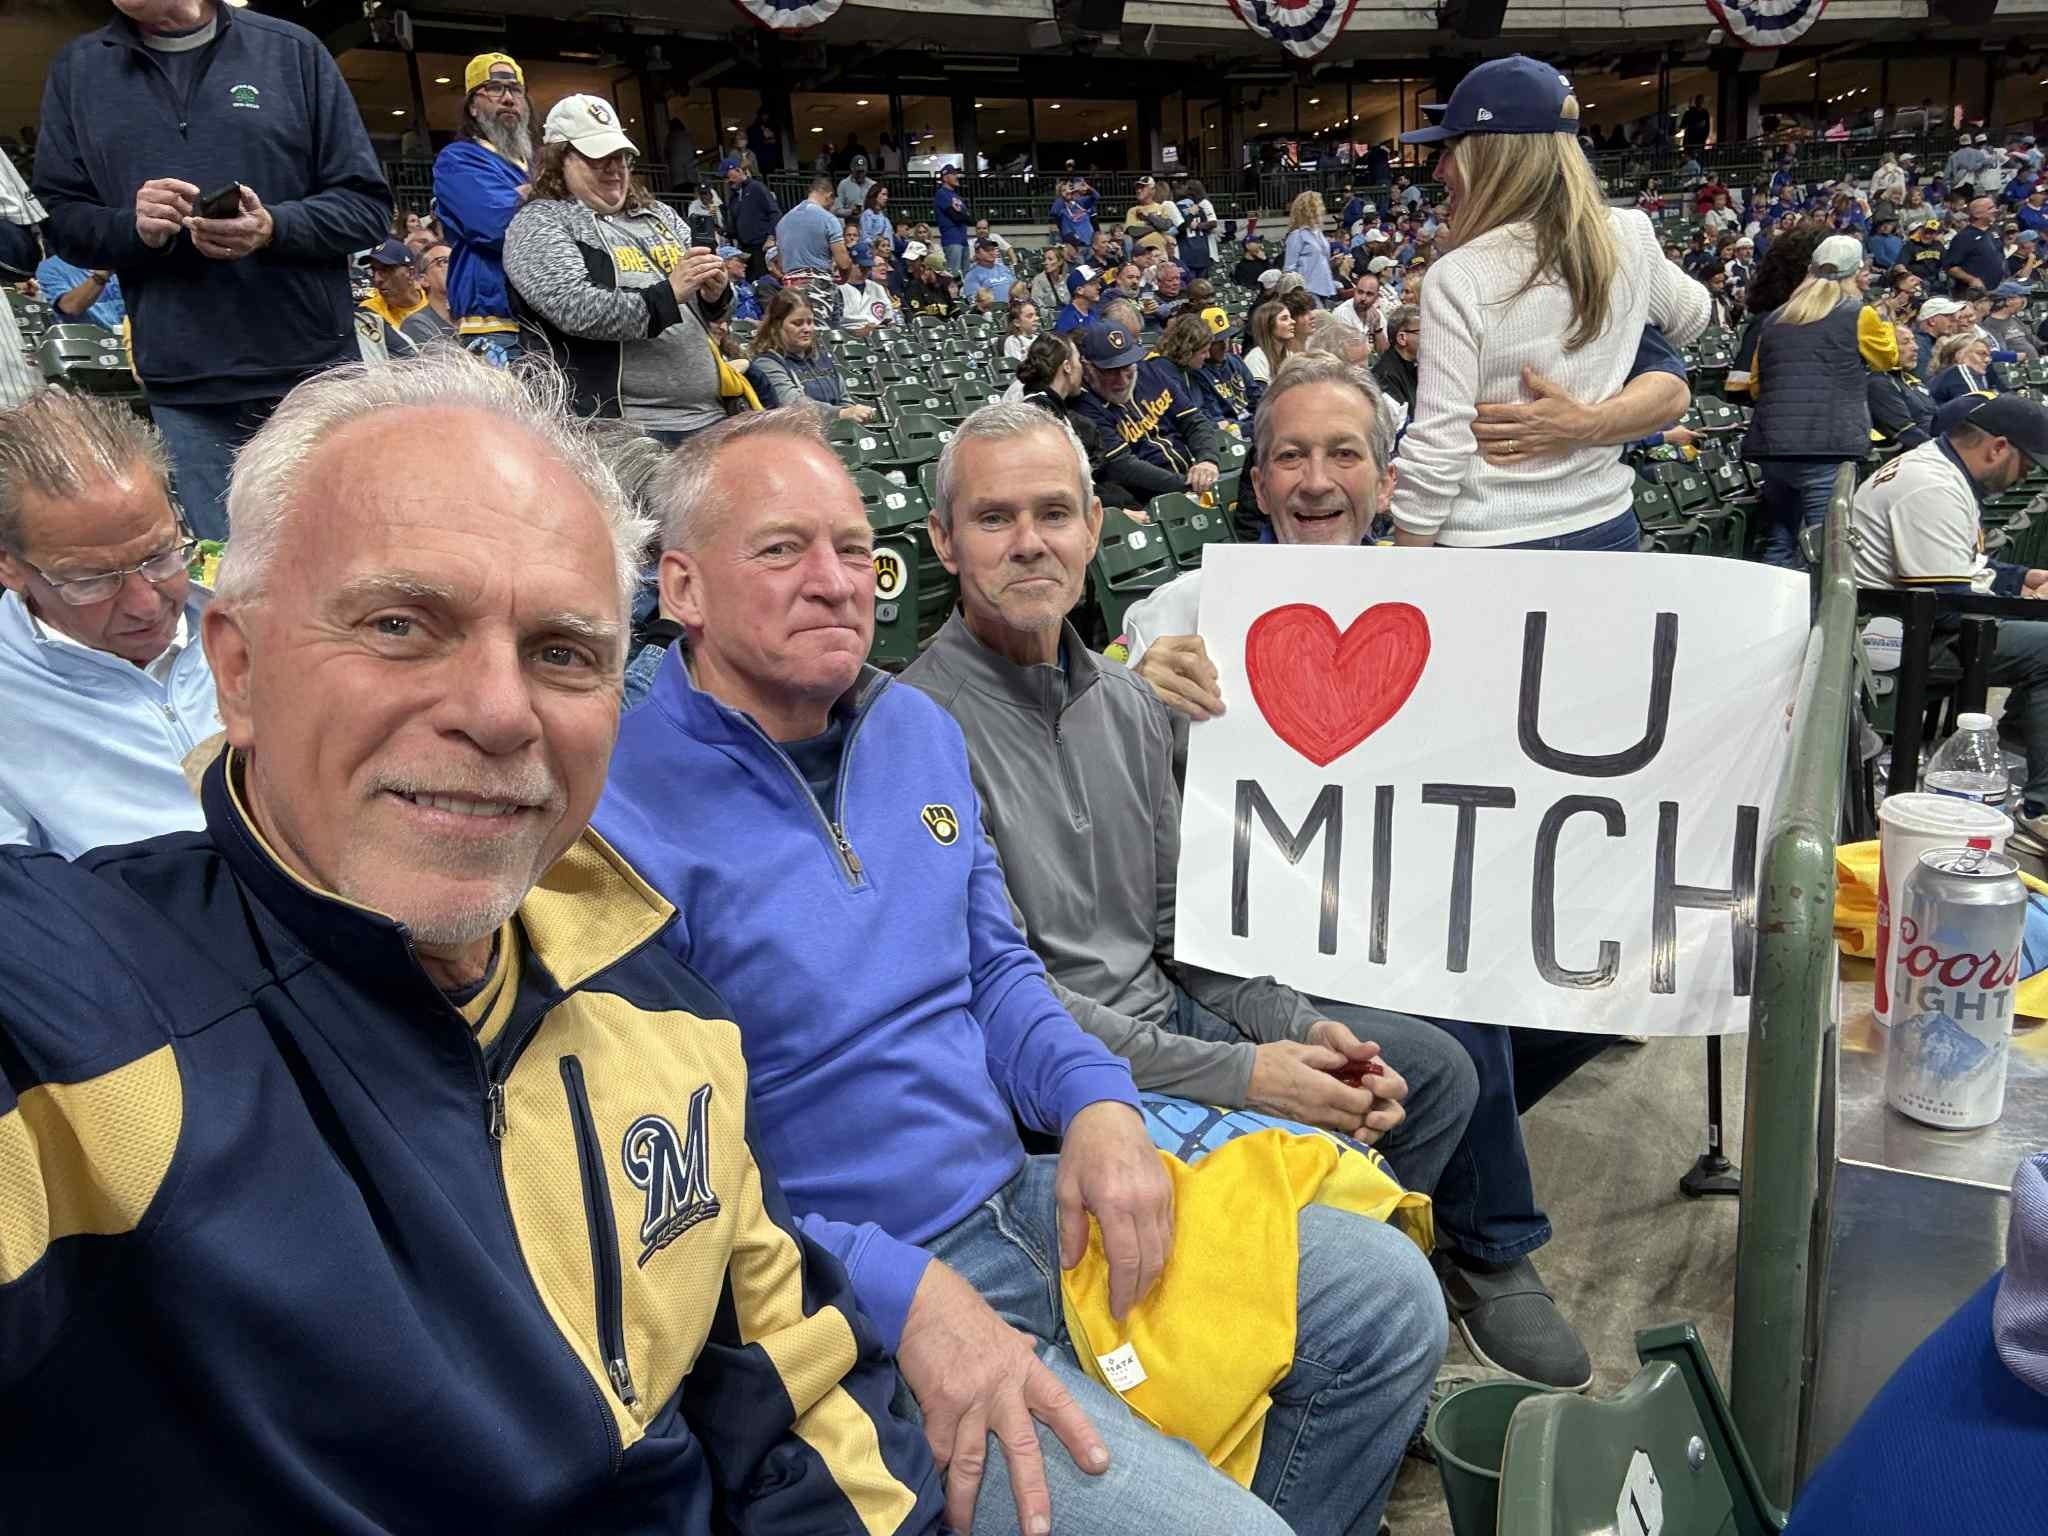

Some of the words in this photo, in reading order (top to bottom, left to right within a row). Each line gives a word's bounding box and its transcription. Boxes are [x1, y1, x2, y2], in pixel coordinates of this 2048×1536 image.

[882, 607, 890, 618] 6
[1517, 611, 1679, 778] U
[1231, 779, 1760, 997] MITCH
